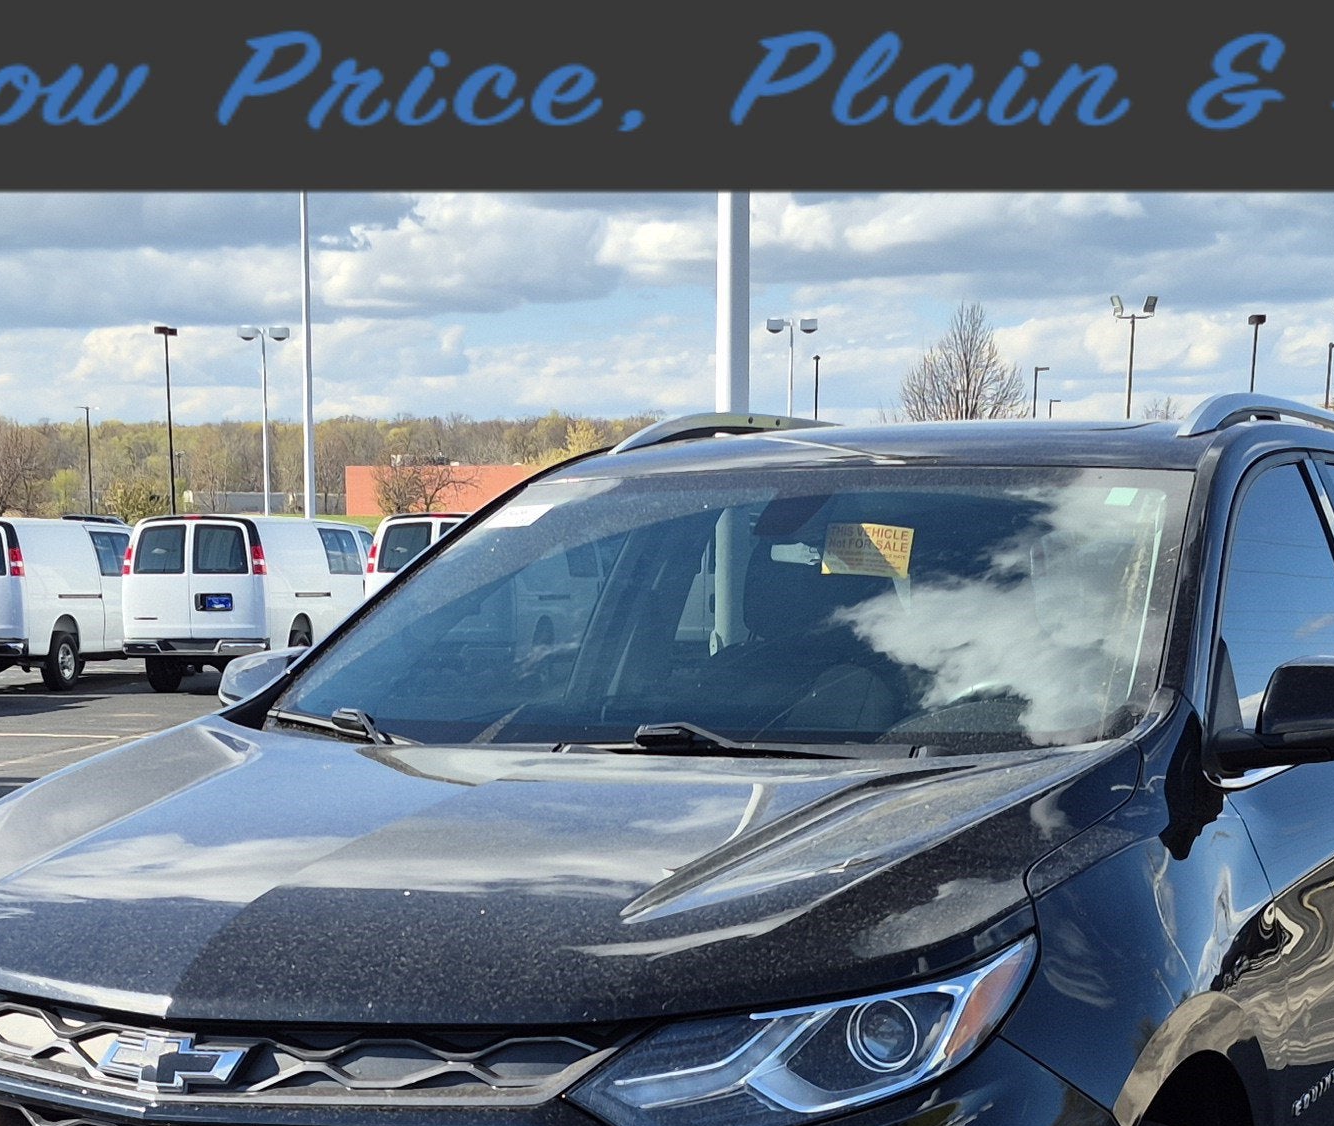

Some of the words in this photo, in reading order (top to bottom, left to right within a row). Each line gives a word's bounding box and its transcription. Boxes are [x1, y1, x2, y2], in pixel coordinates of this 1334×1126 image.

[831, 526, 854, 537] THIS
[857, 527, 909, 541] VEHICLE
[876, 541, 908, 553] SALE
